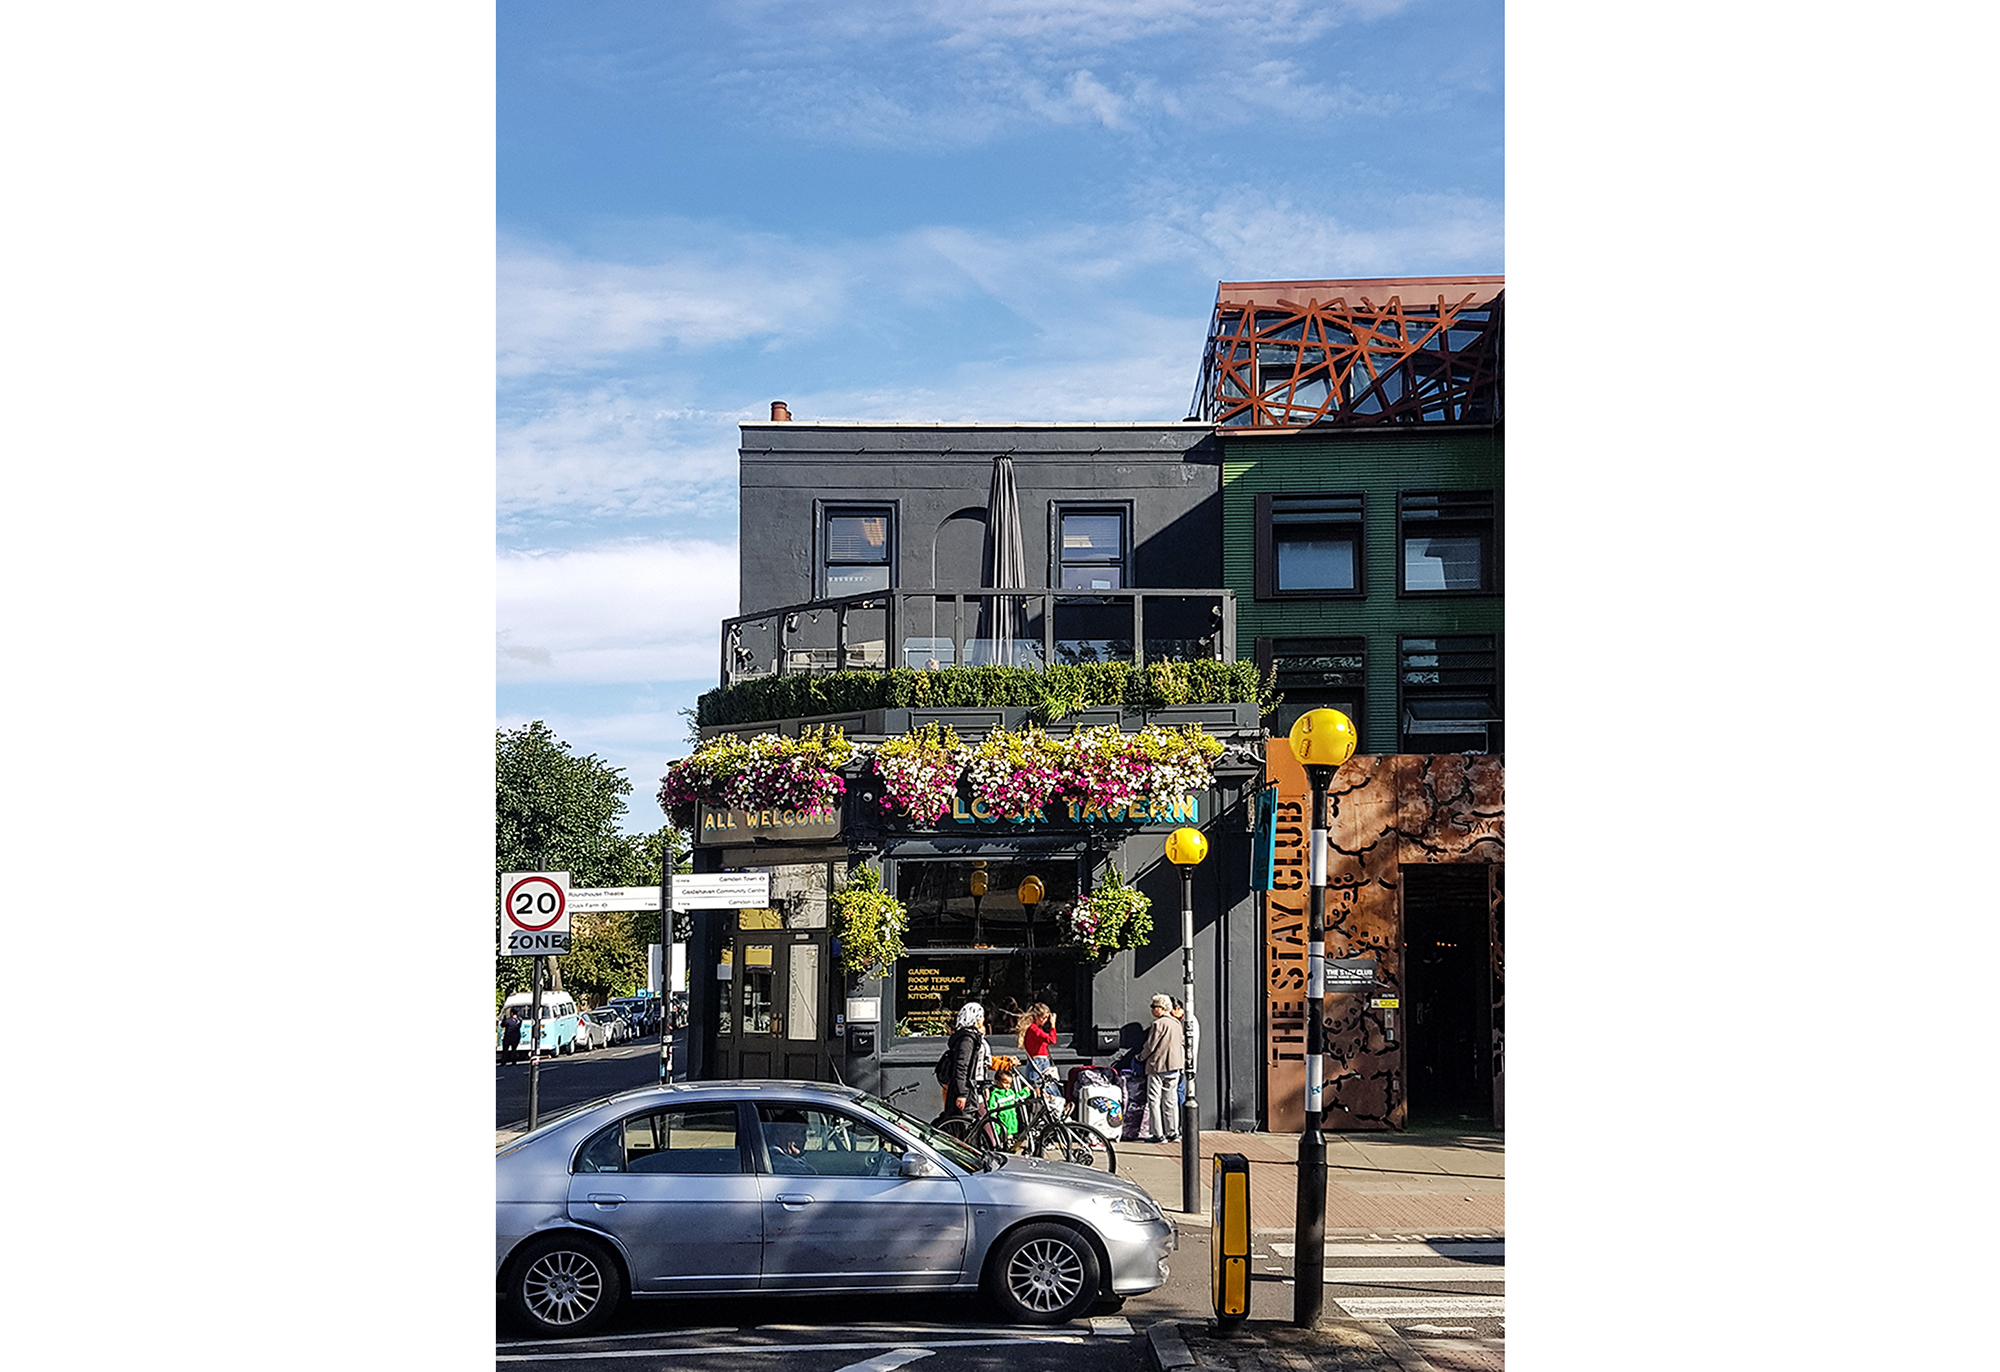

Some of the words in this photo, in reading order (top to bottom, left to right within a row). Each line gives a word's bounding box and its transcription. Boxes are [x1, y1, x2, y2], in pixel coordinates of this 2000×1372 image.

[704, 812, 737, 831] ALL
[1451, 811, 1494, 837] STAY
[1273, 802, 1303, 891] CLUB
[515, 892, 556, 915] 20
[508, 935, 562, 949] ZONE
[1271, 901, 1304, 990] STAY
[1272, 1001, 1304, 1068] THE
